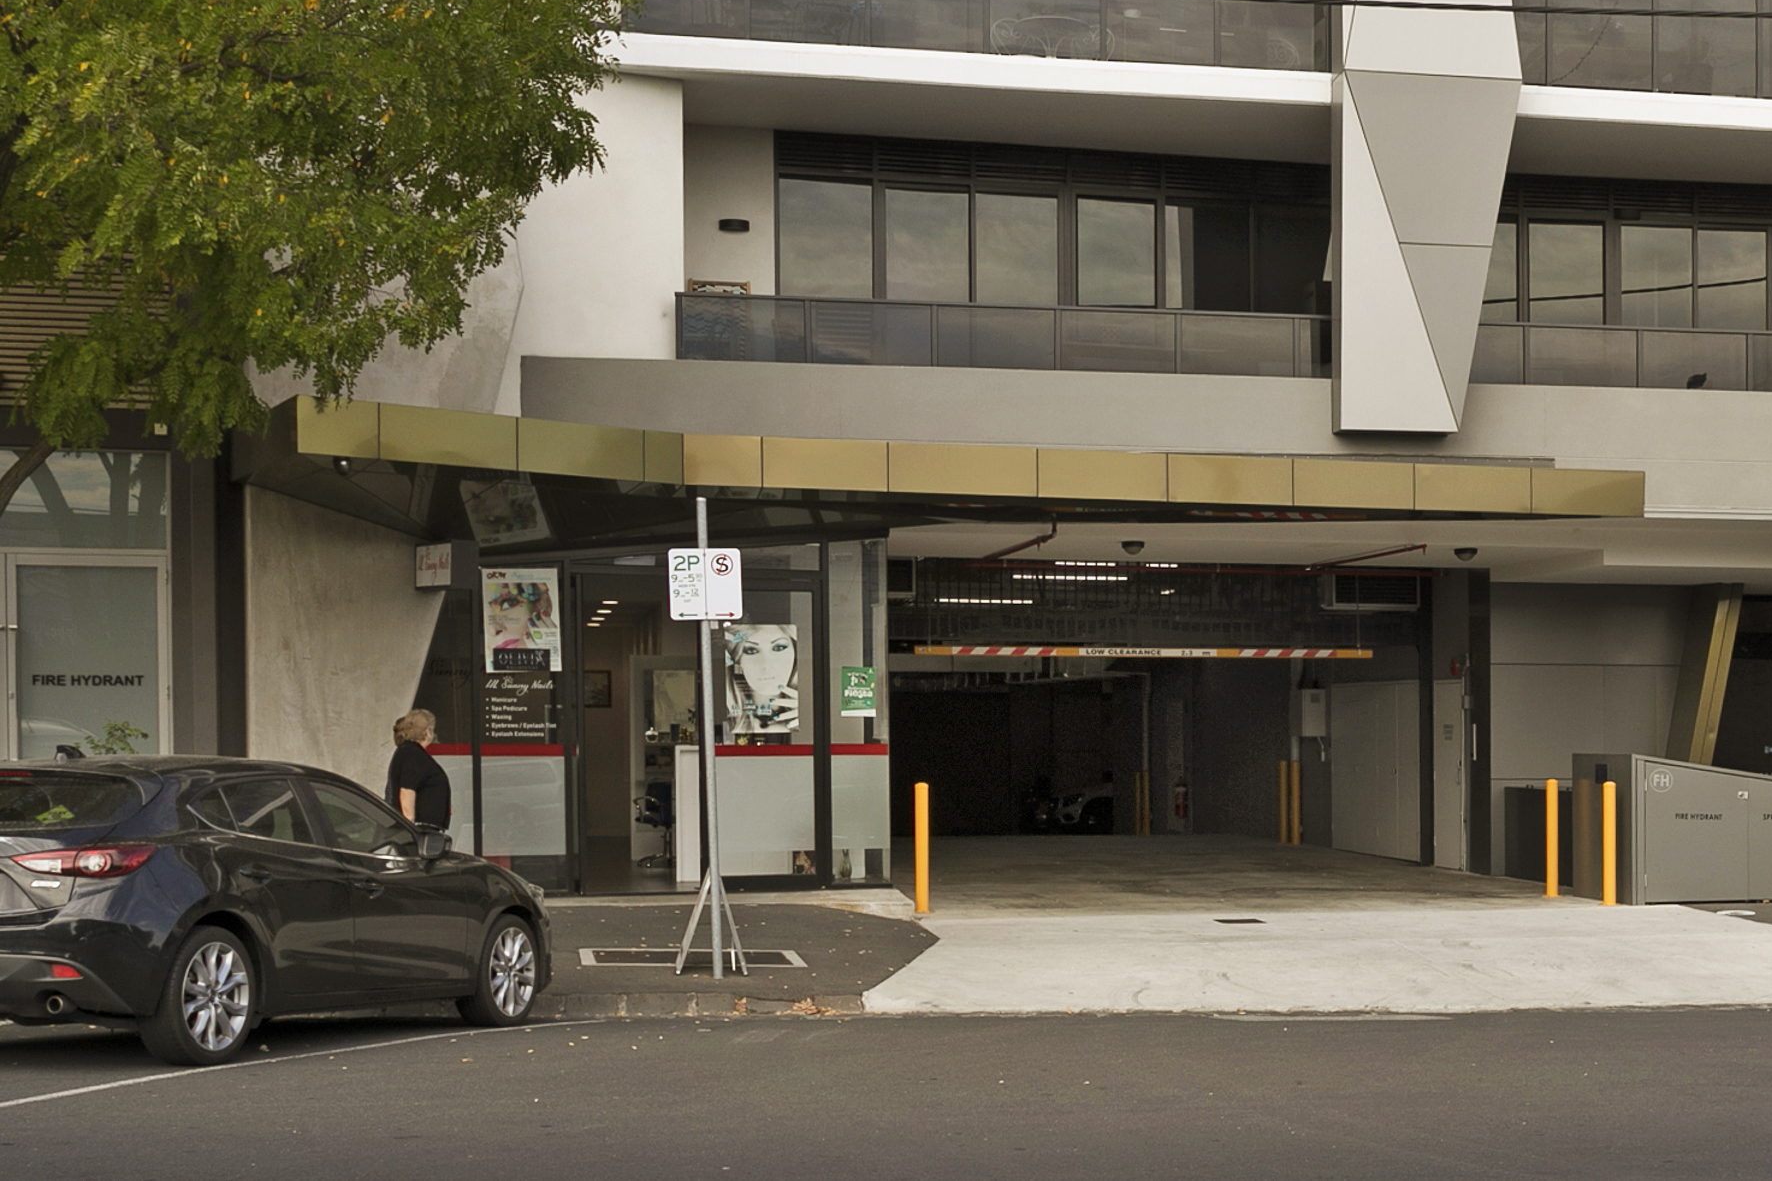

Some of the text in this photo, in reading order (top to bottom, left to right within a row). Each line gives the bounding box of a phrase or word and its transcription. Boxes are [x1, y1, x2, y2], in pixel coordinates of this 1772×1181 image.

[673, 555, 700, 571] 2P
[1108, 648, 1162, 656] CLEARANCE
[31, 674, 145, 687] FIRE HYDRANT
[1652, 773, 1671, 788] FH
[1675, 812, 1723, 821] FIRE HYDRANT
